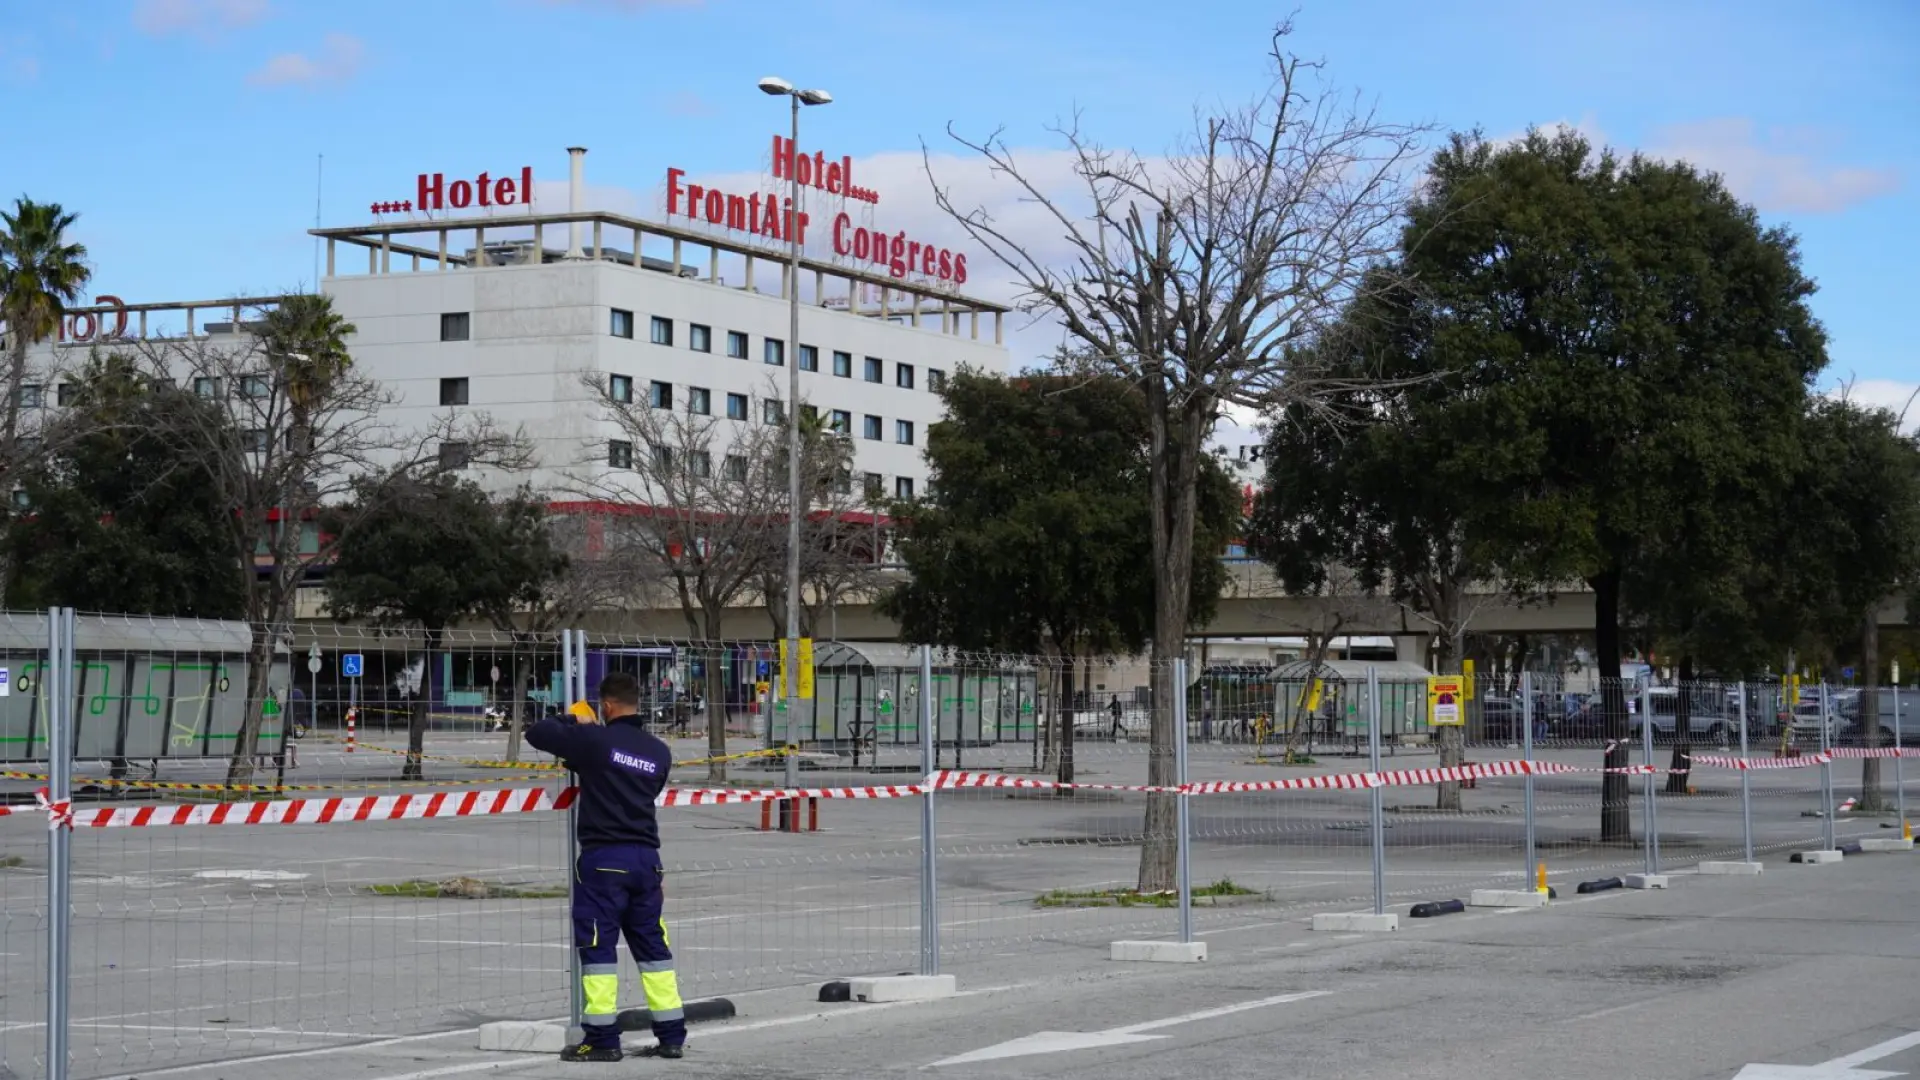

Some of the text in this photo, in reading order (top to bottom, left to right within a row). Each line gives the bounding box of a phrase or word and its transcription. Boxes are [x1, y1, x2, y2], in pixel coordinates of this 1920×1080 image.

[418, 166, 531, 211] Hotel
[773, 135, 851, 198] Hotel
[667, 167, 967, 284] FrontAir Congress
[613, 751, 656, 773] RUBATEC
